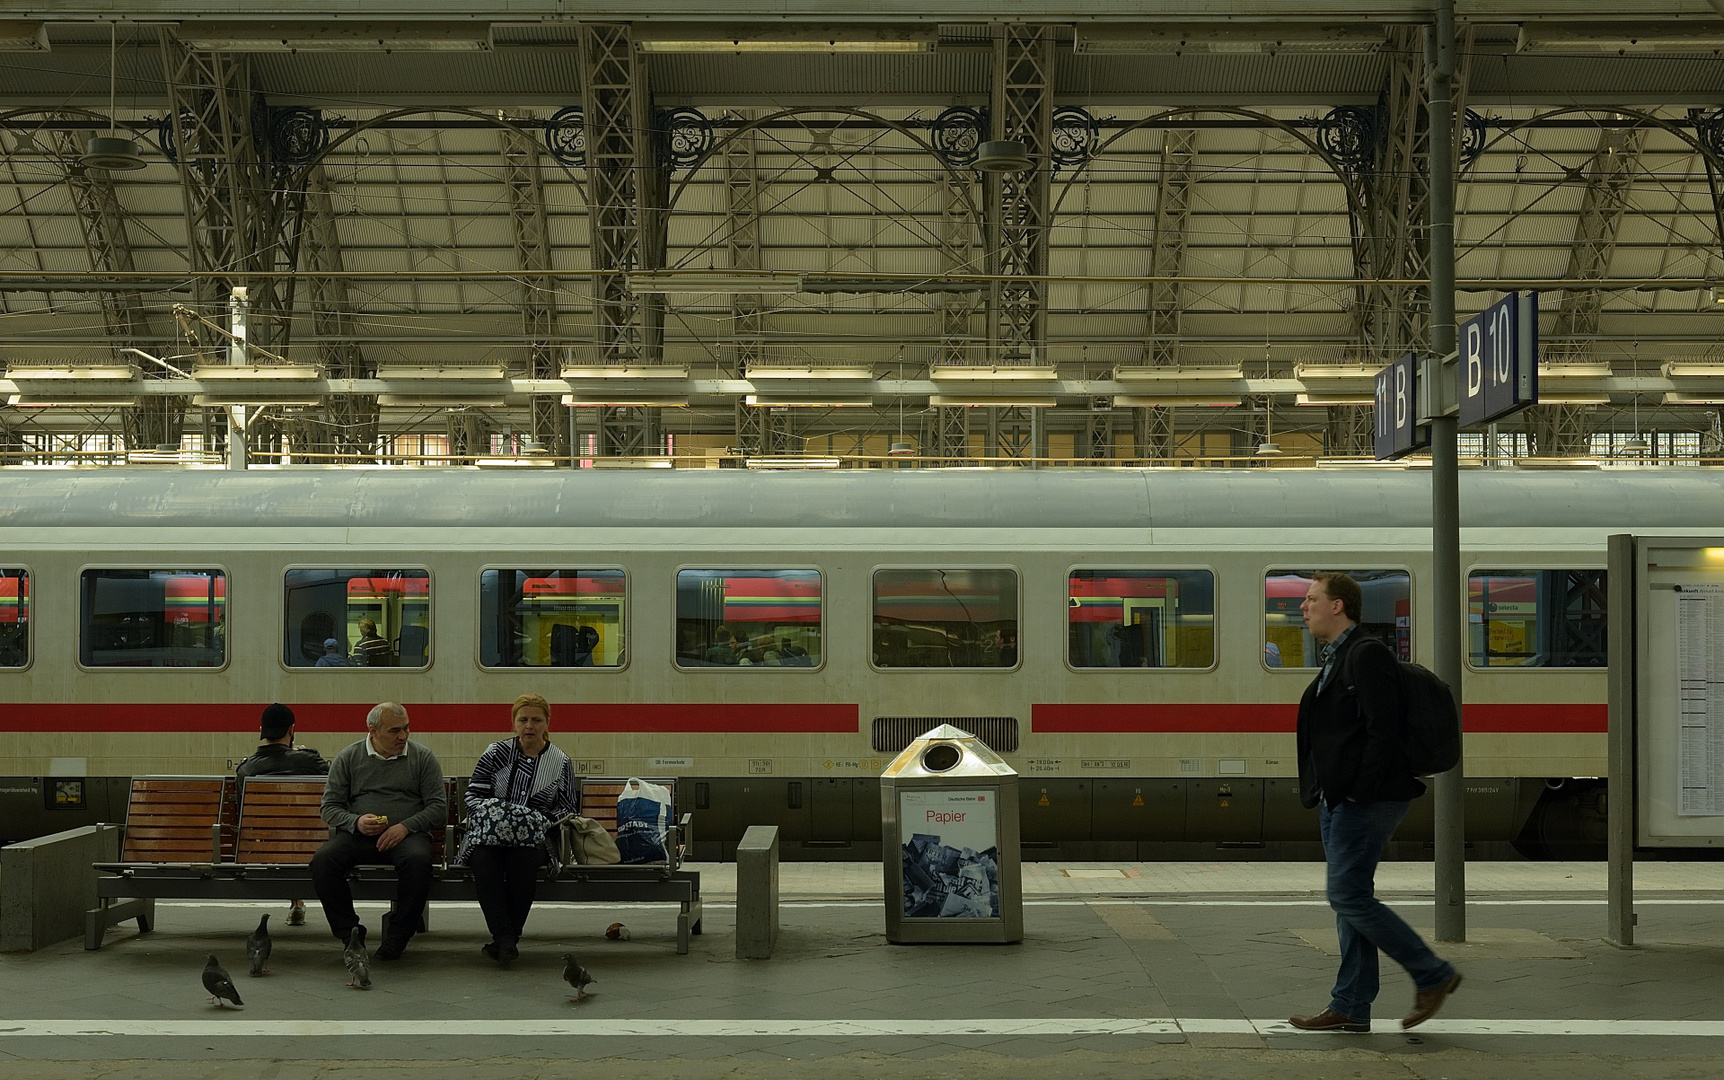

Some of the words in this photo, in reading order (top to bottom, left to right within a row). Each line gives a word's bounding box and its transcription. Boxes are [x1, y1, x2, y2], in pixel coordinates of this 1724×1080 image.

[1468, 322, 1482, 398] B
[1489, 304, 1510, 388] 10
[1376, 374, 1387, 438] 11
[1397, 364, 1406, 430] B
[926, 810, 967, 825] Papier
